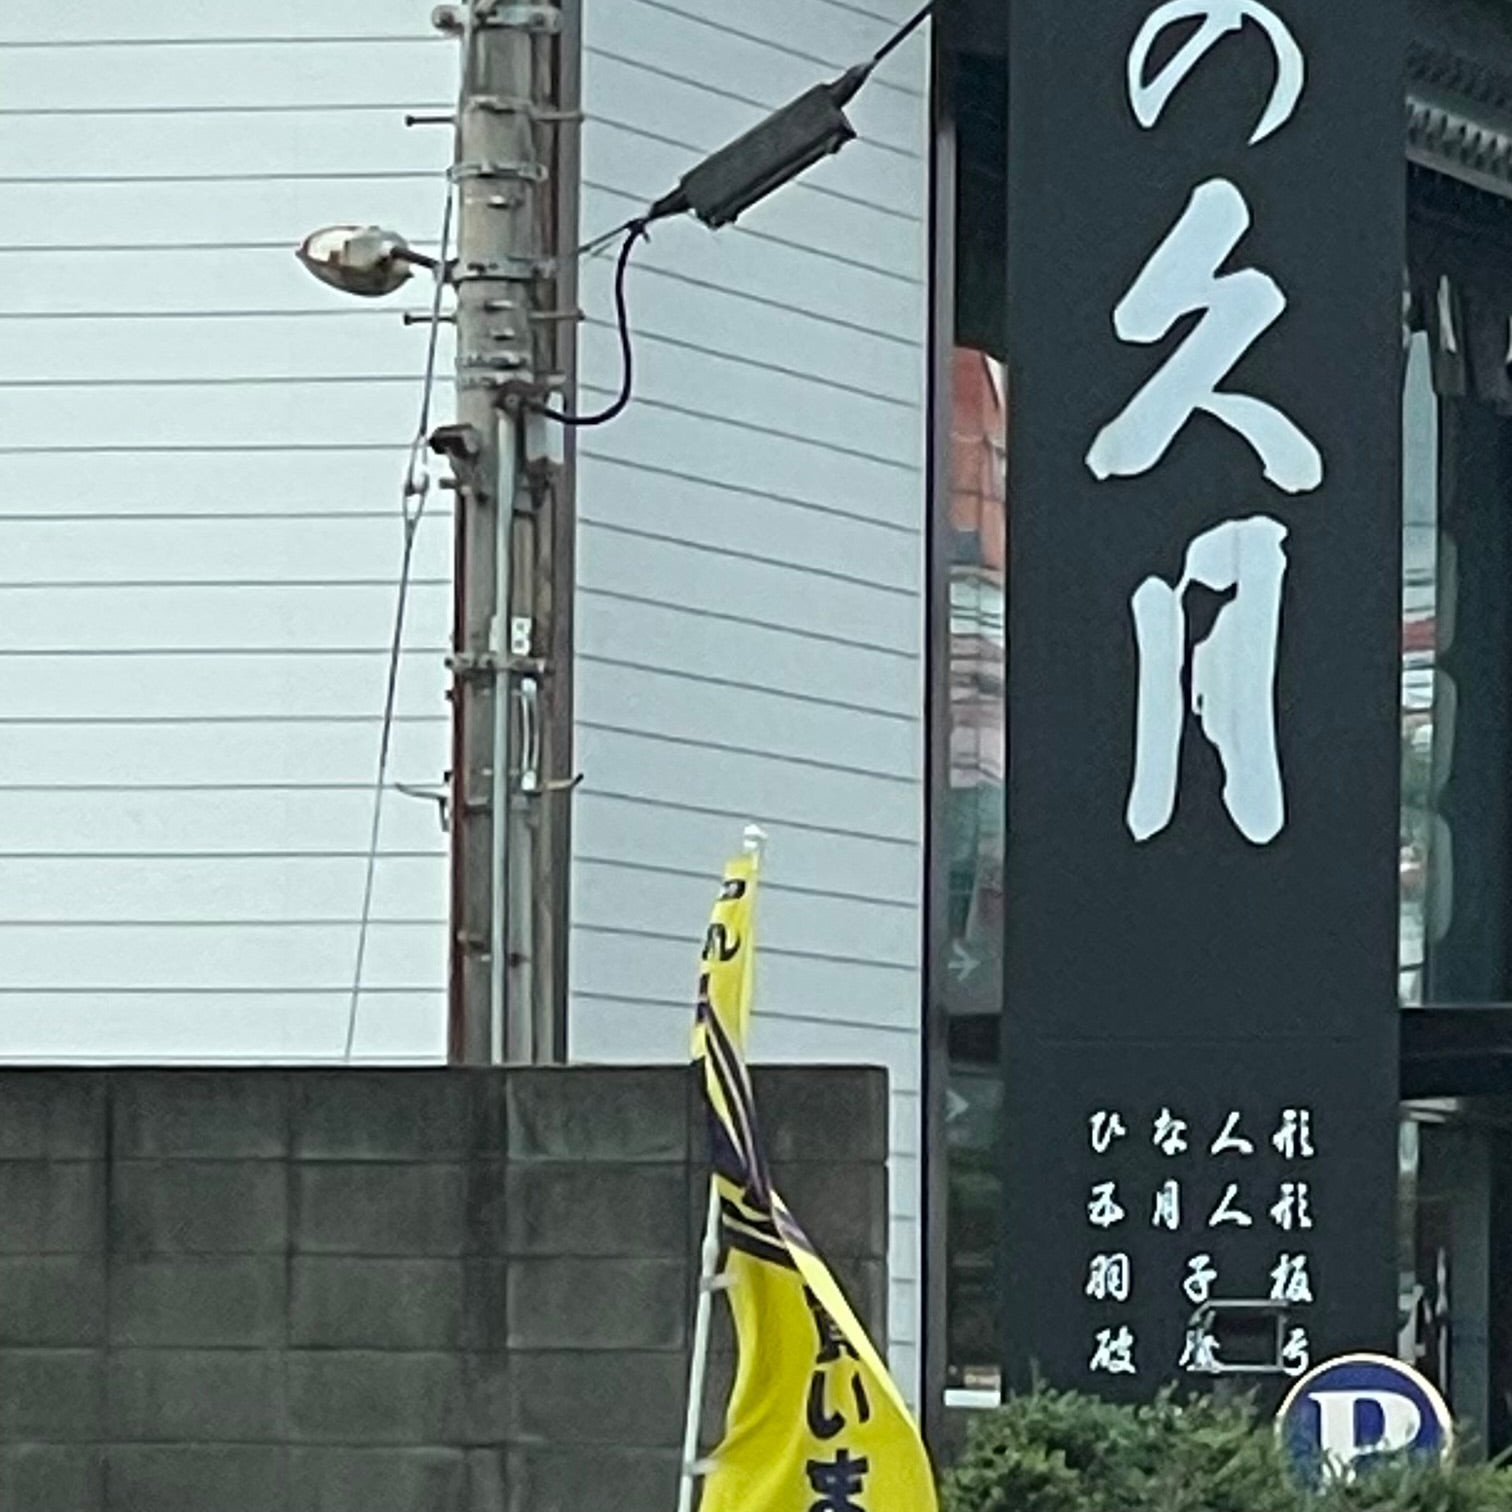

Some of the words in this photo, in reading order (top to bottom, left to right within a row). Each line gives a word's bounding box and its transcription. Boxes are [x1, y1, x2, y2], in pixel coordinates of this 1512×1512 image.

[1089, 1106, 1315, 1159] ひな人形
[1087, 1179, 1313, 1231] 五月人形
[1085, 1252, 1314, 1302] 羽子板
[1307, 1388, 1422, 1486] P
